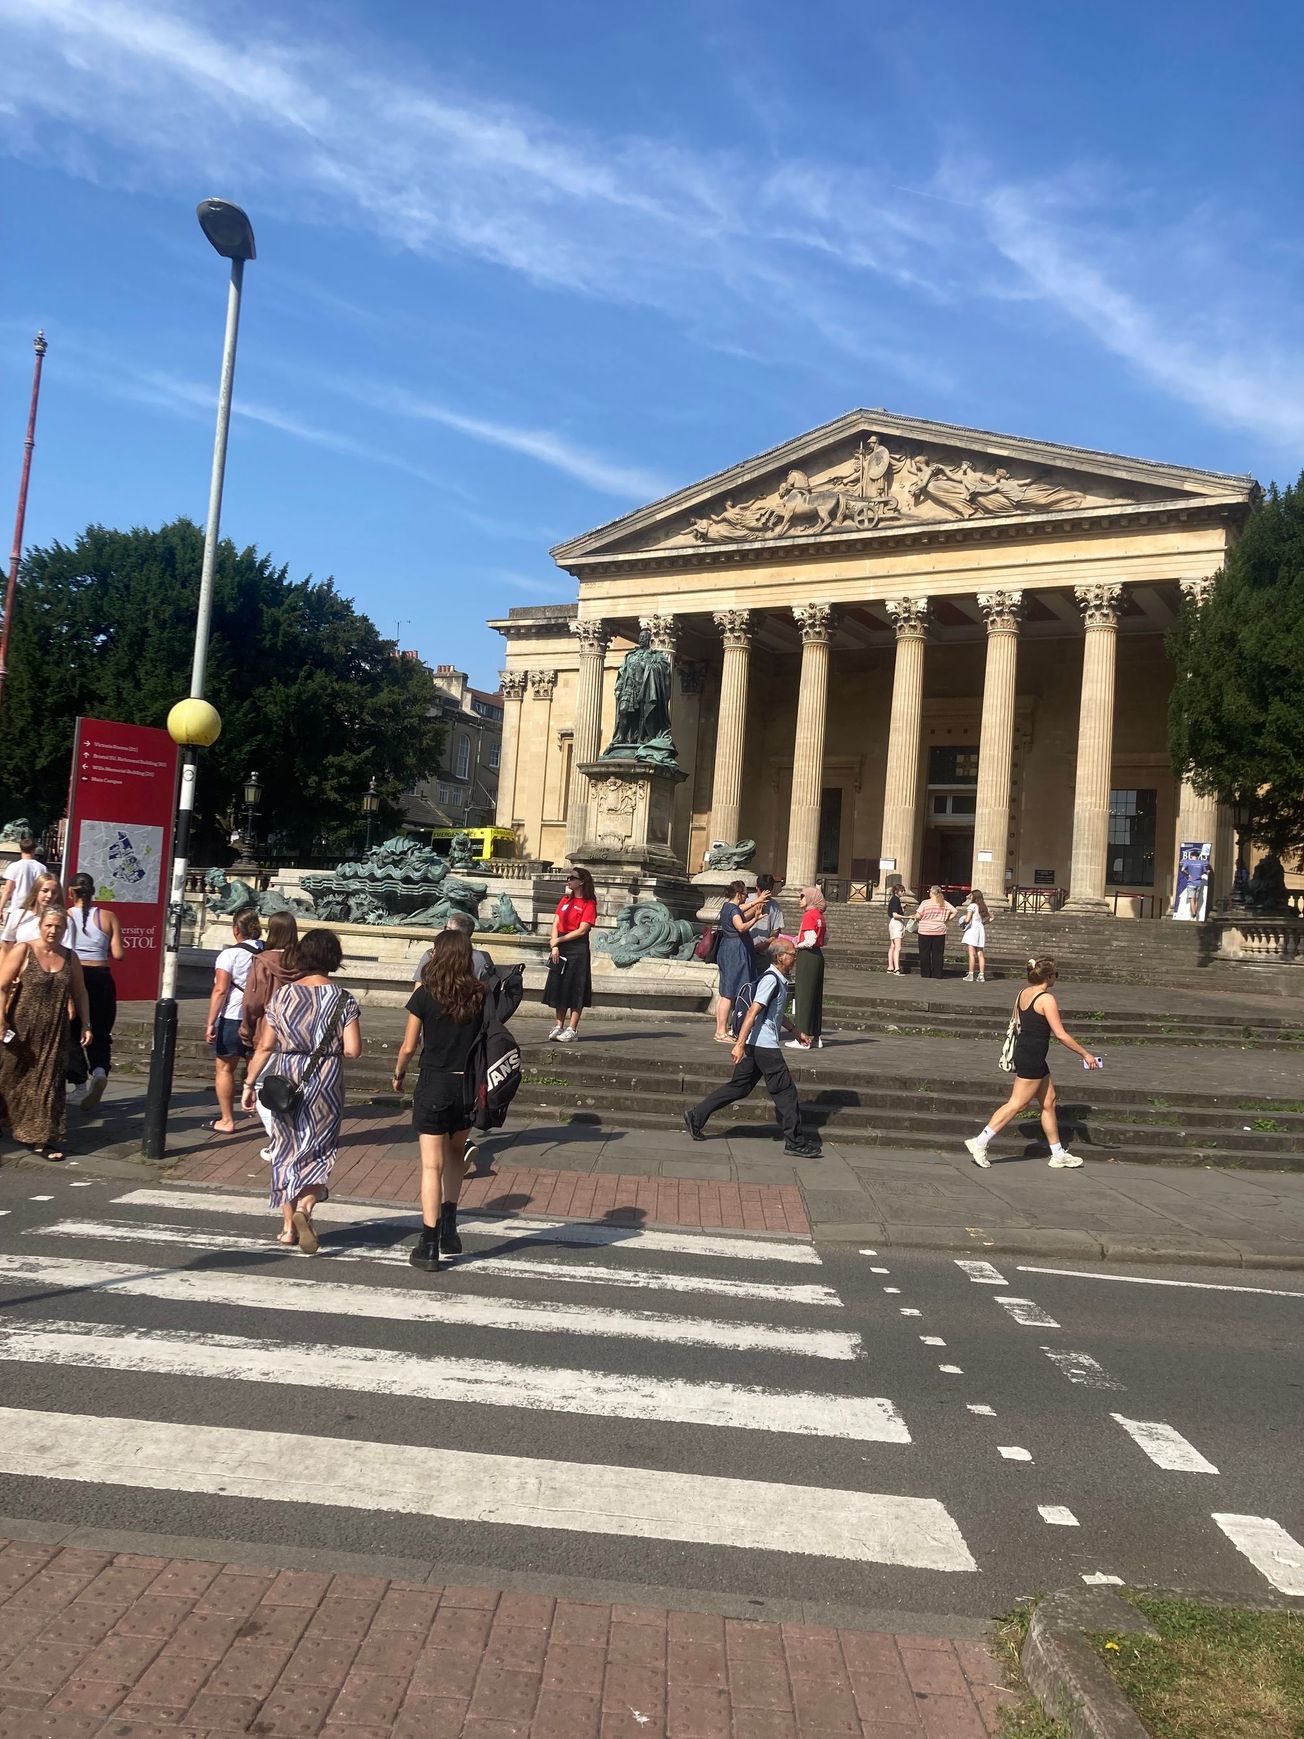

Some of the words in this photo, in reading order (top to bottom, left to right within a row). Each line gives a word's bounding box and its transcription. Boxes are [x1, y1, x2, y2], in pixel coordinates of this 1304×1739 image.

[120, 925, 144, 936] ersity
[146, 925, 157, 935] of
[121, 936, 157, 949] STOL
